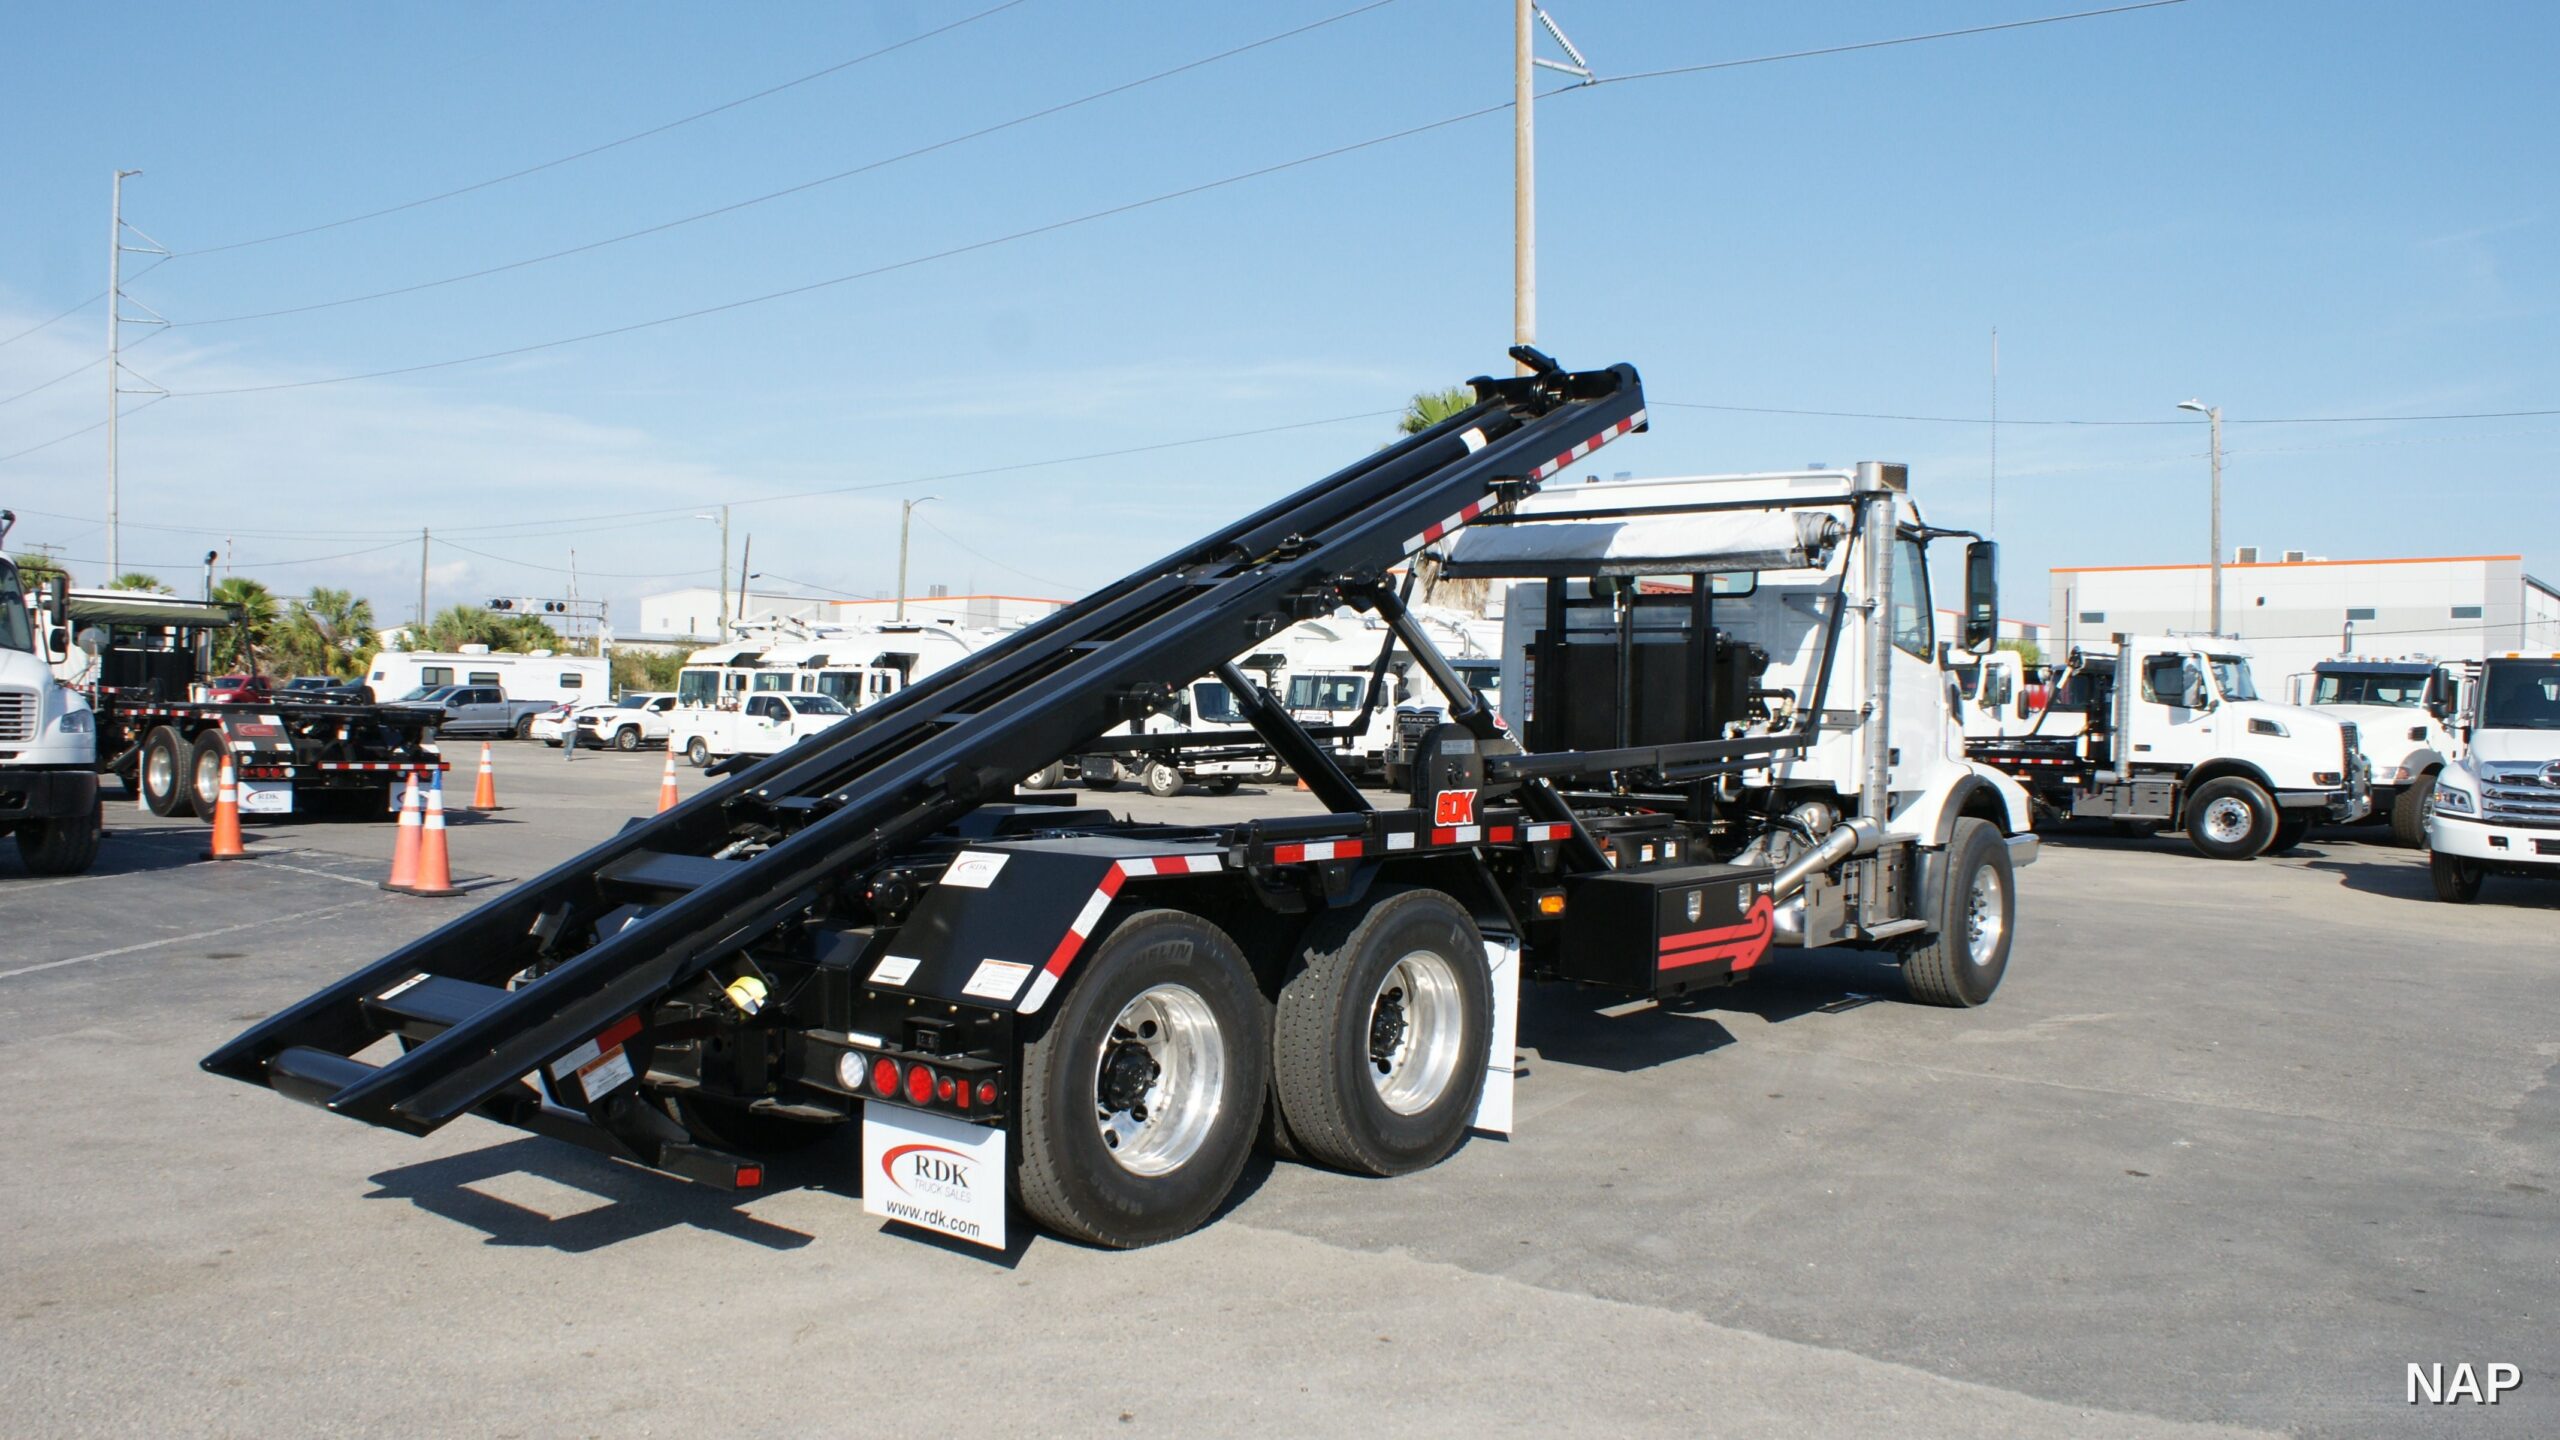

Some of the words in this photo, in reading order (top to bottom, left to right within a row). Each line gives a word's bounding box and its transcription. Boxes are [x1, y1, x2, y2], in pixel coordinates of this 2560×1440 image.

[915, 1154, 969, 1189] RDK
[915, 1178, 943, 1195] TRUCK
[945, 1185, 971, 1203] SALES
[886, 1200, 981, 1237] www.rdk.com
